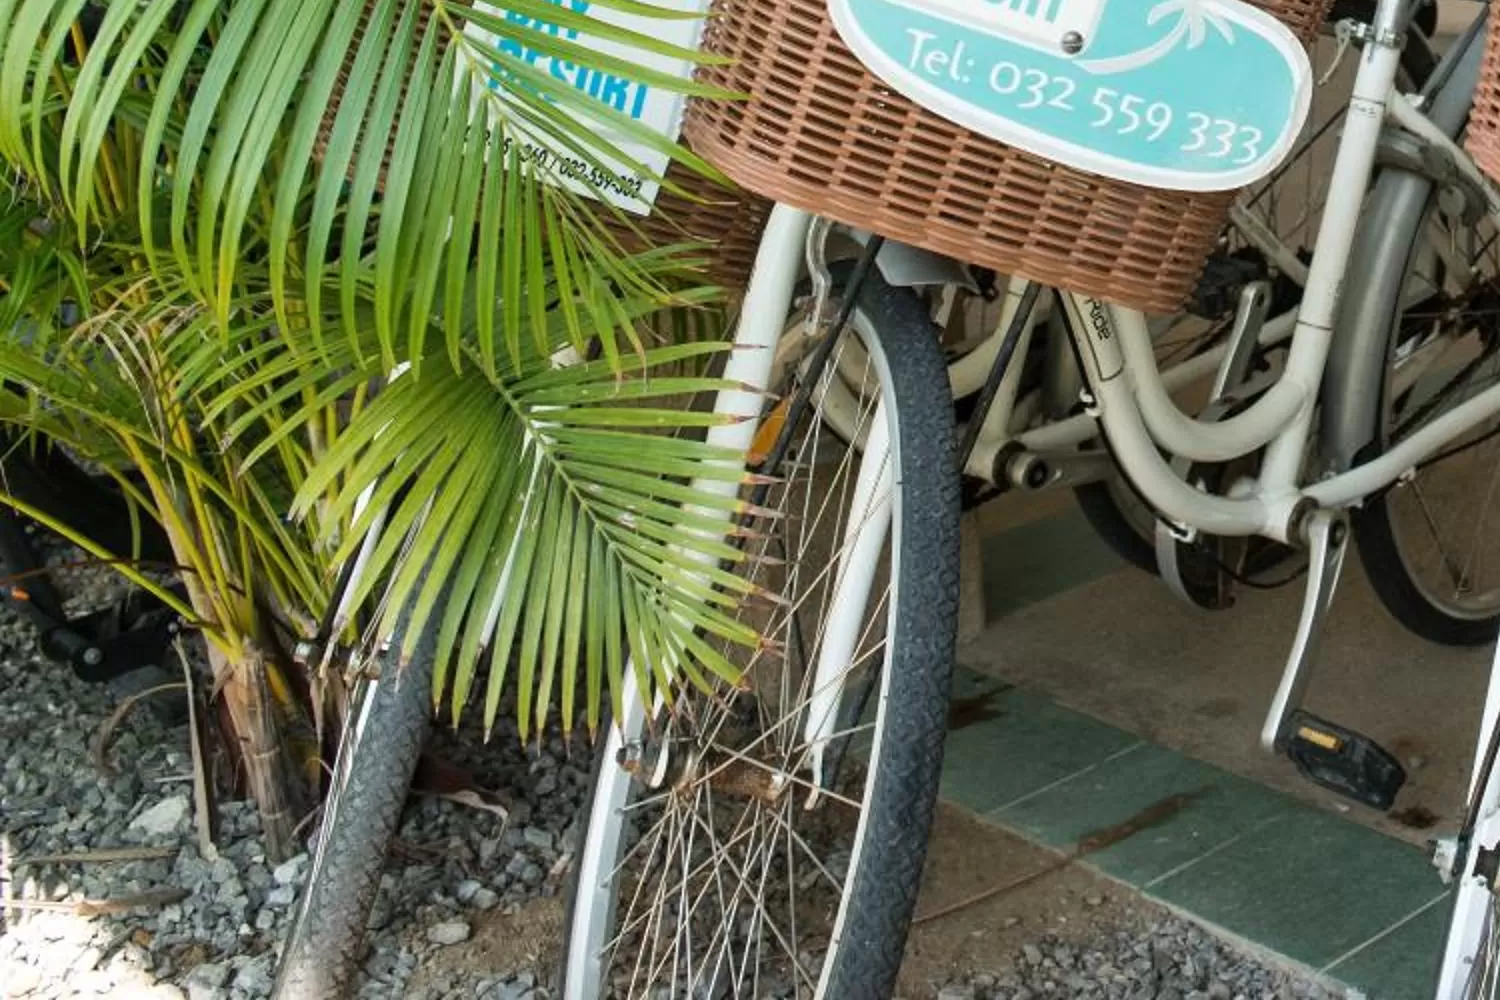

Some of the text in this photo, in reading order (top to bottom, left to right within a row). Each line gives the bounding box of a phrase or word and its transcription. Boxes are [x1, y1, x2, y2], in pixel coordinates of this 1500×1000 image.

[906, 28, 1262, 165] Tel: 032 559 333
